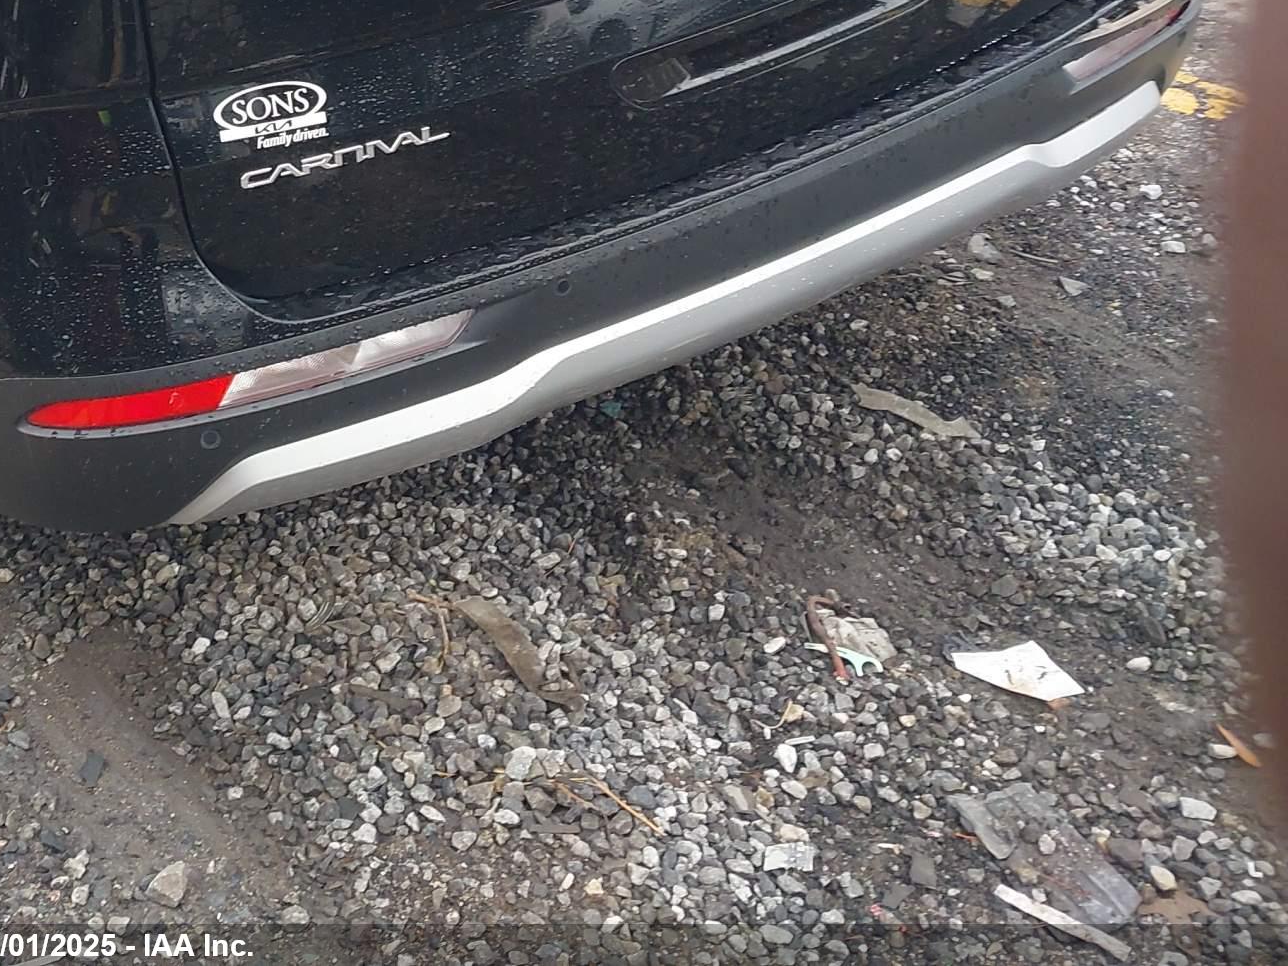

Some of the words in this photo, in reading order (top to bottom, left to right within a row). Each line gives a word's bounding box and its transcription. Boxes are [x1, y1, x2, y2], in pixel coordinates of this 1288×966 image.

[231, 87, 310, 125] SONS
[240, 126, 450, 189] CARNIVAL
[256, 130, 292, 150] Family
[292, 127, 330, 143] driven.
